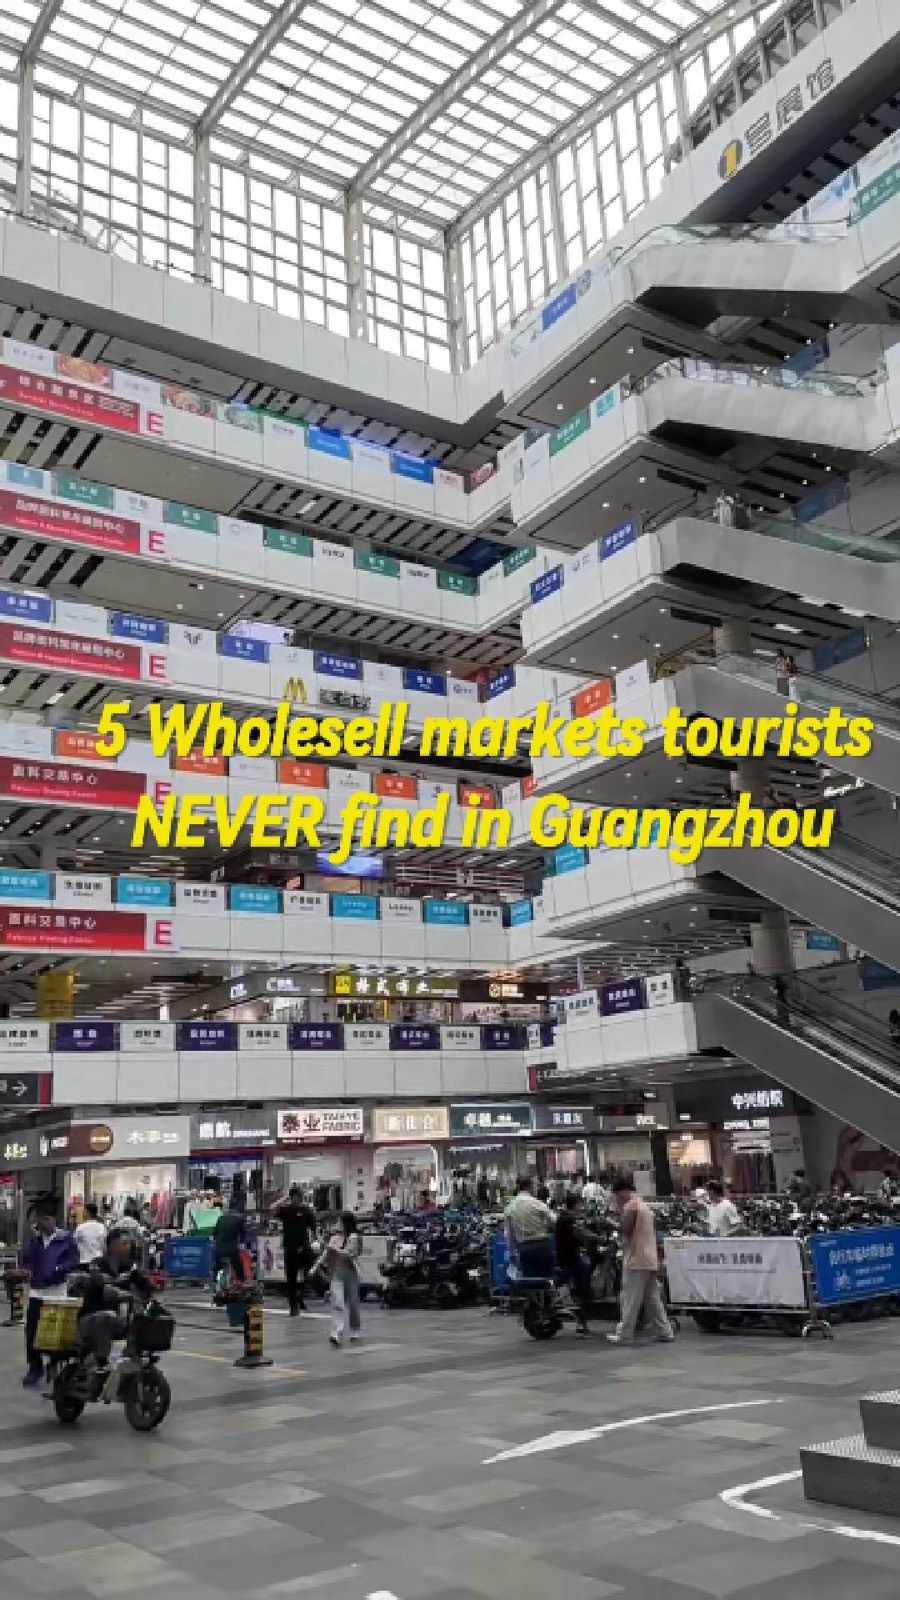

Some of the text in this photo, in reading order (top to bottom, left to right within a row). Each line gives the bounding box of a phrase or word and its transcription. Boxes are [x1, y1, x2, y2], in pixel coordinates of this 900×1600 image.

[147, 411, 164, 436] E
[148, 530, 165, 554] E
[149, 655, 167, 679] E
[153, 919, 173, 946] E
